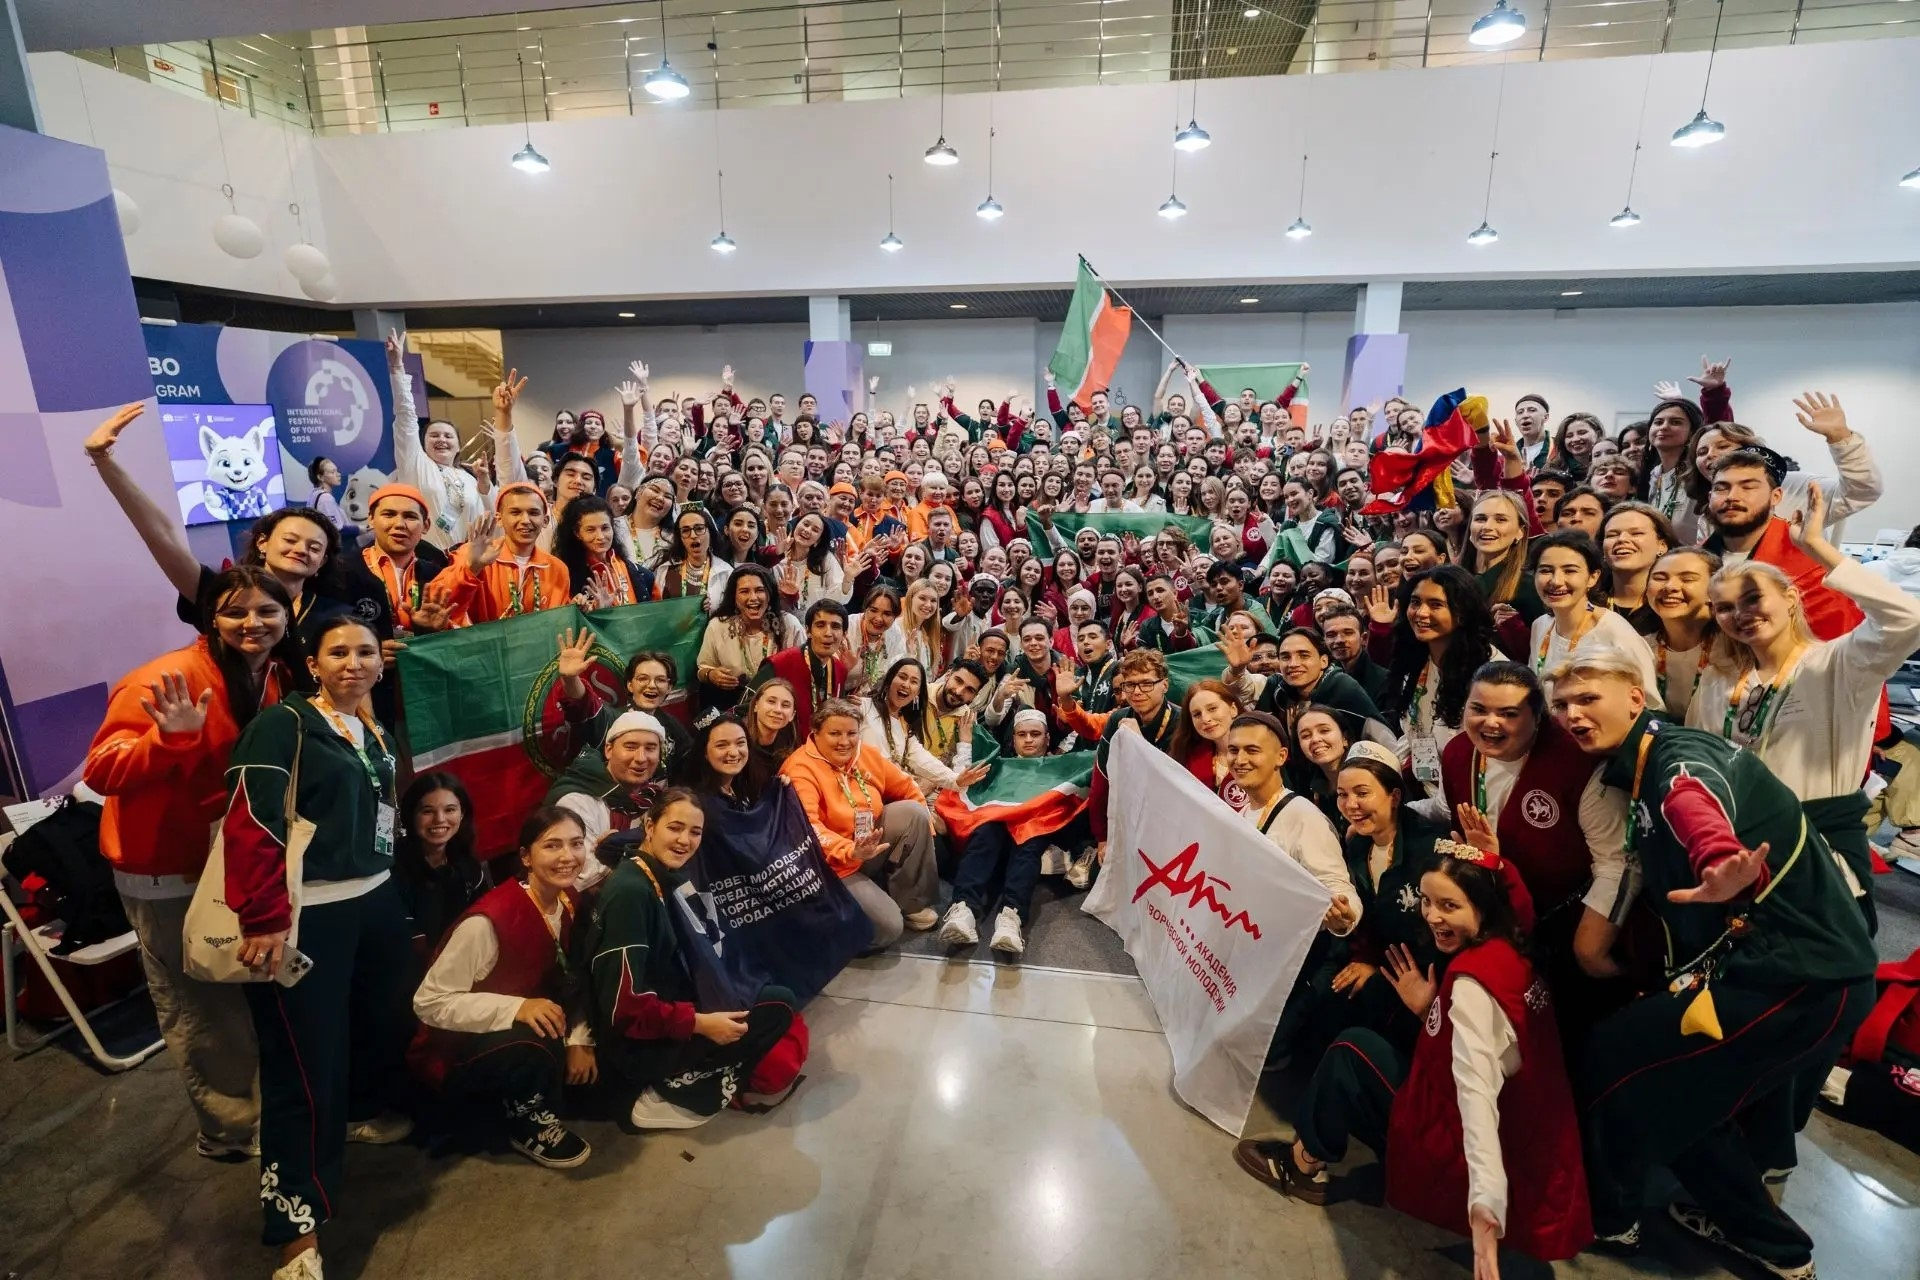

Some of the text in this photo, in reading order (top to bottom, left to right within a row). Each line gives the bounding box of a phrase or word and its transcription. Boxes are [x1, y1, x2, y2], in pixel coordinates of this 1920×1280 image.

[155, 384, 200, 398] GRAM
[286, 408, 344, 416] INTERNATIONAL
[288, 417, 322, 425] FESTIVAL
[290, 426, 327, 434] OF YOUTH
[708, 835, 812, 893] СОВЕТ МОЛОДЕЖИ
[727, 868, 816, 915] ОРГАИЗАЦИЙ
[729, 877, 823, 929] ОРОДА КАЗАНИ
[1194, 941, 1237, 998] АКАДЕМИЯ
